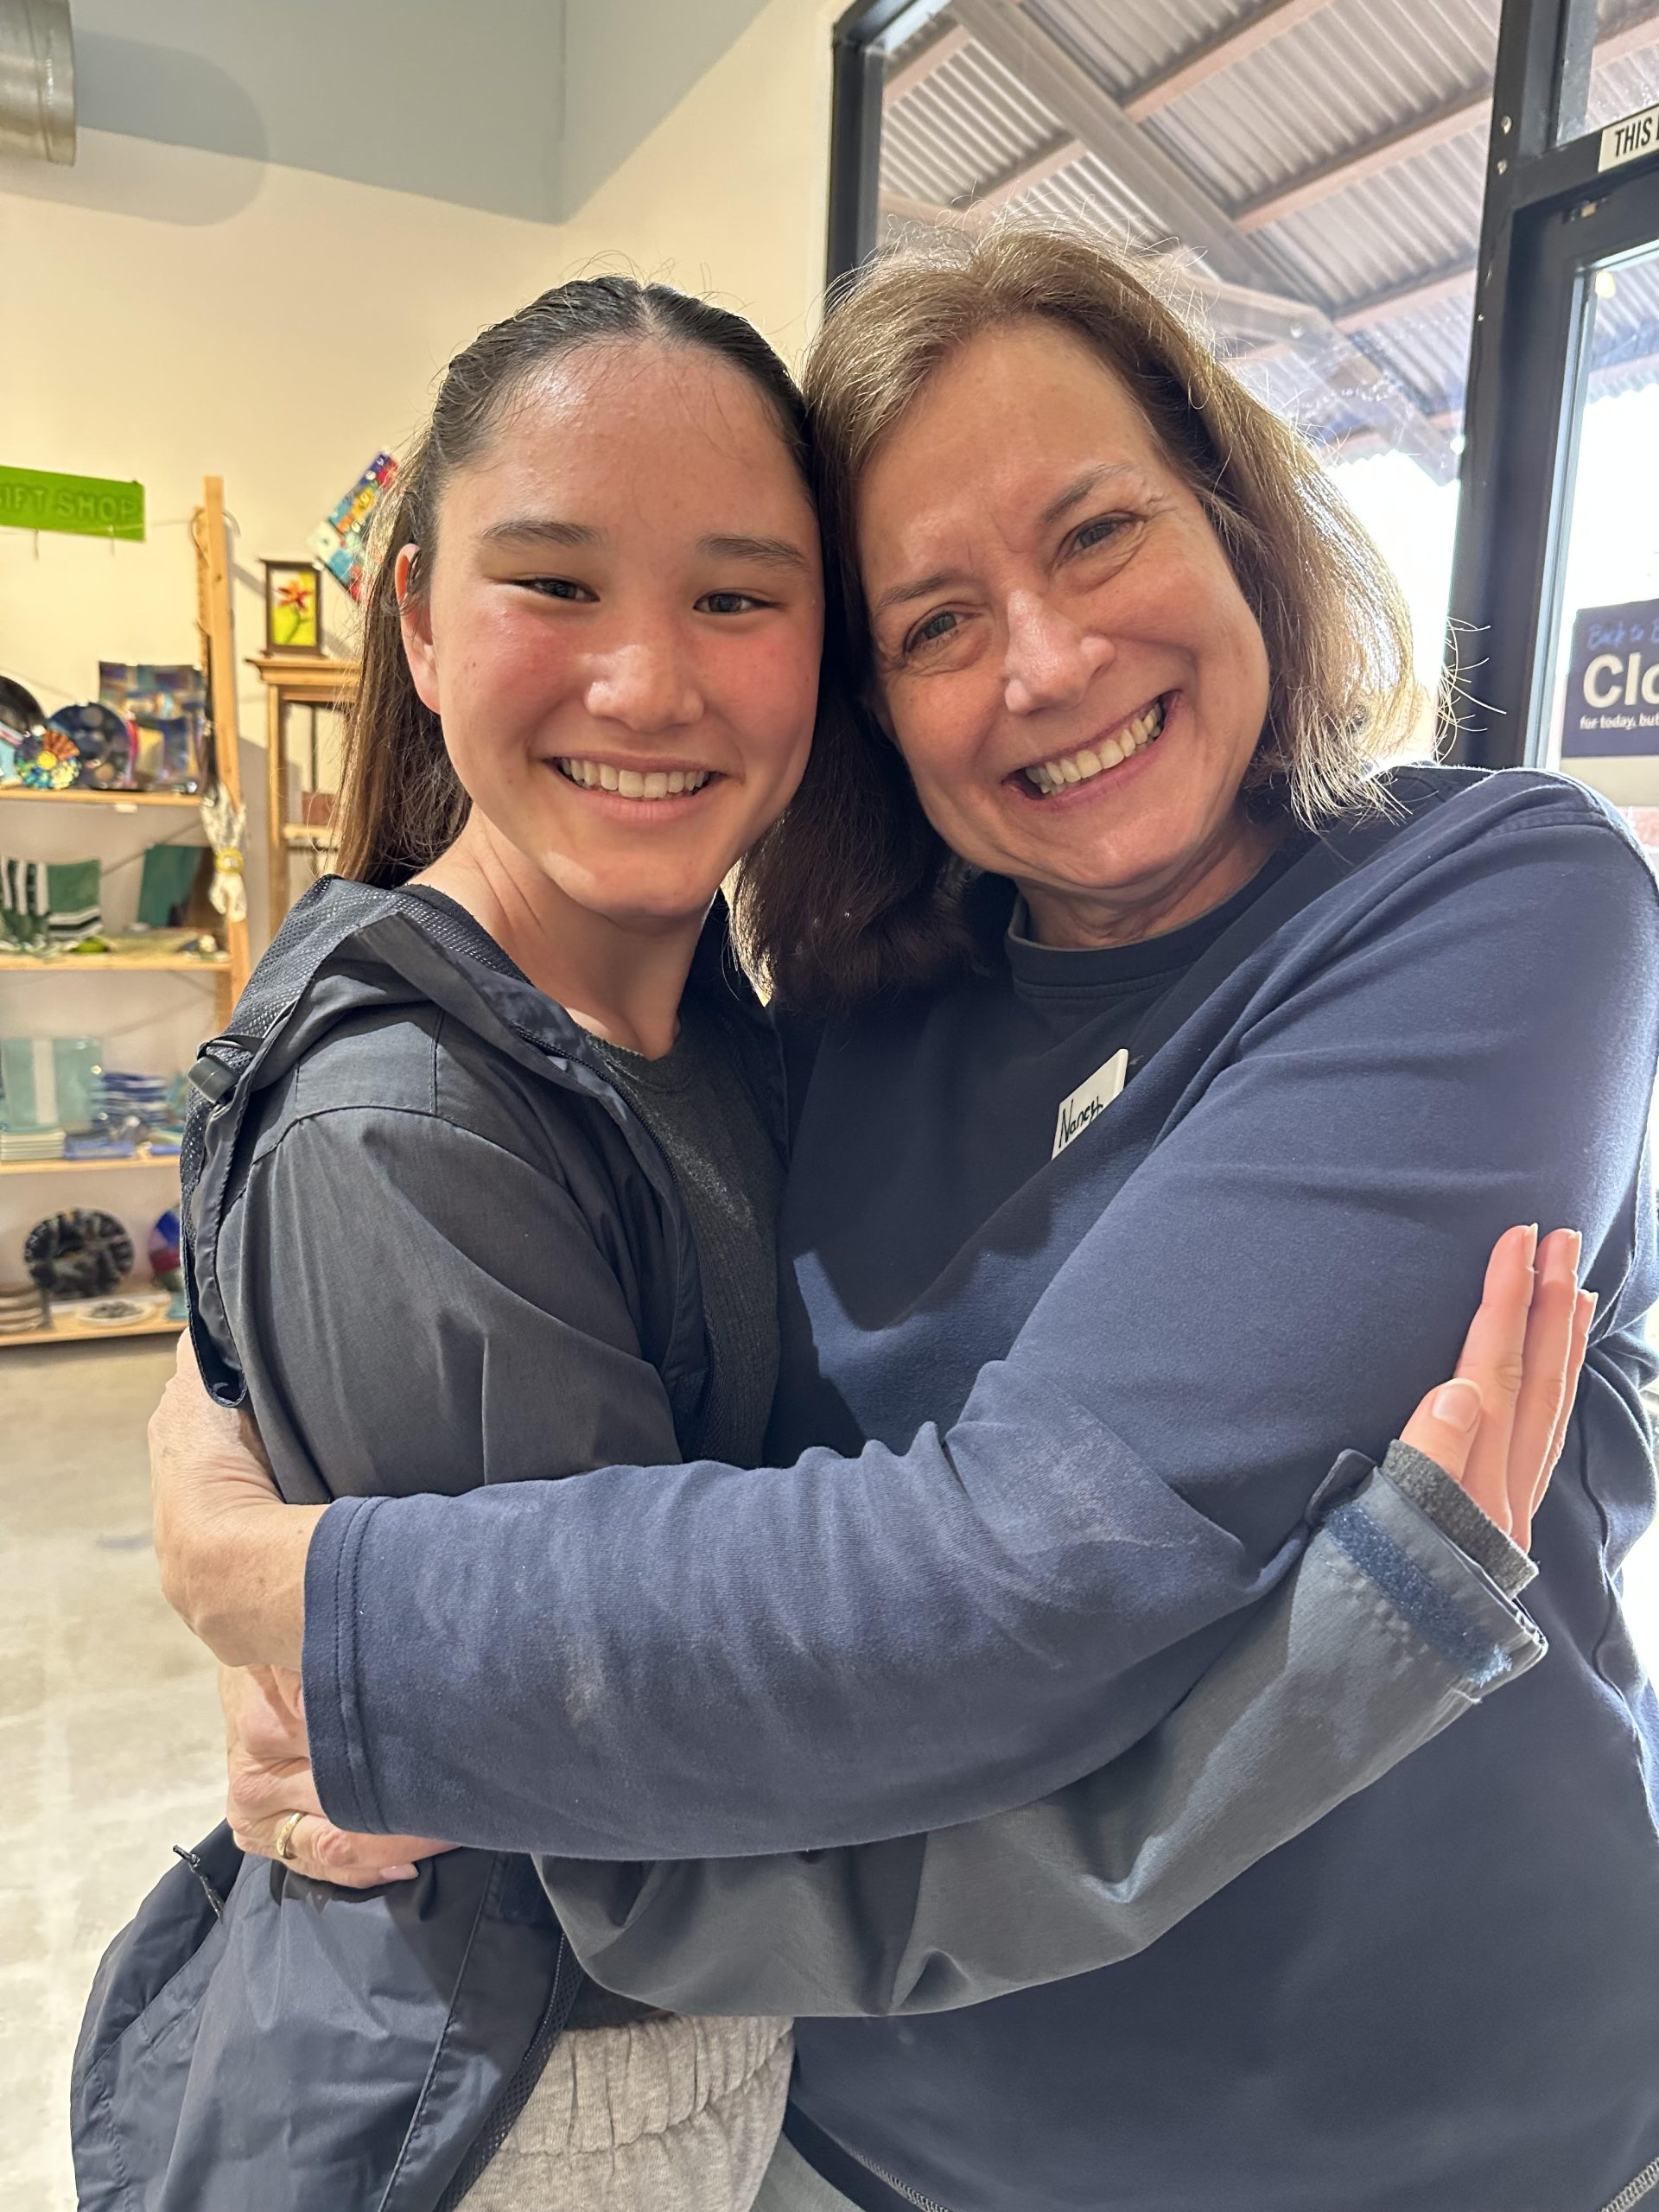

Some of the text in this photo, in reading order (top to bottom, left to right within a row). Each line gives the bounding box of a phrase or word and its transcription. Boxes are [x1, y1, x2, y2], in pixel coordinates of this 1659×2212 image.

[1615, 116, 1652, 157] THIS
[0, 486, 138, 522] IFT SHOP
[1580, 715, 1598, 730] for
[1599, 713, 1637, 731] today,
